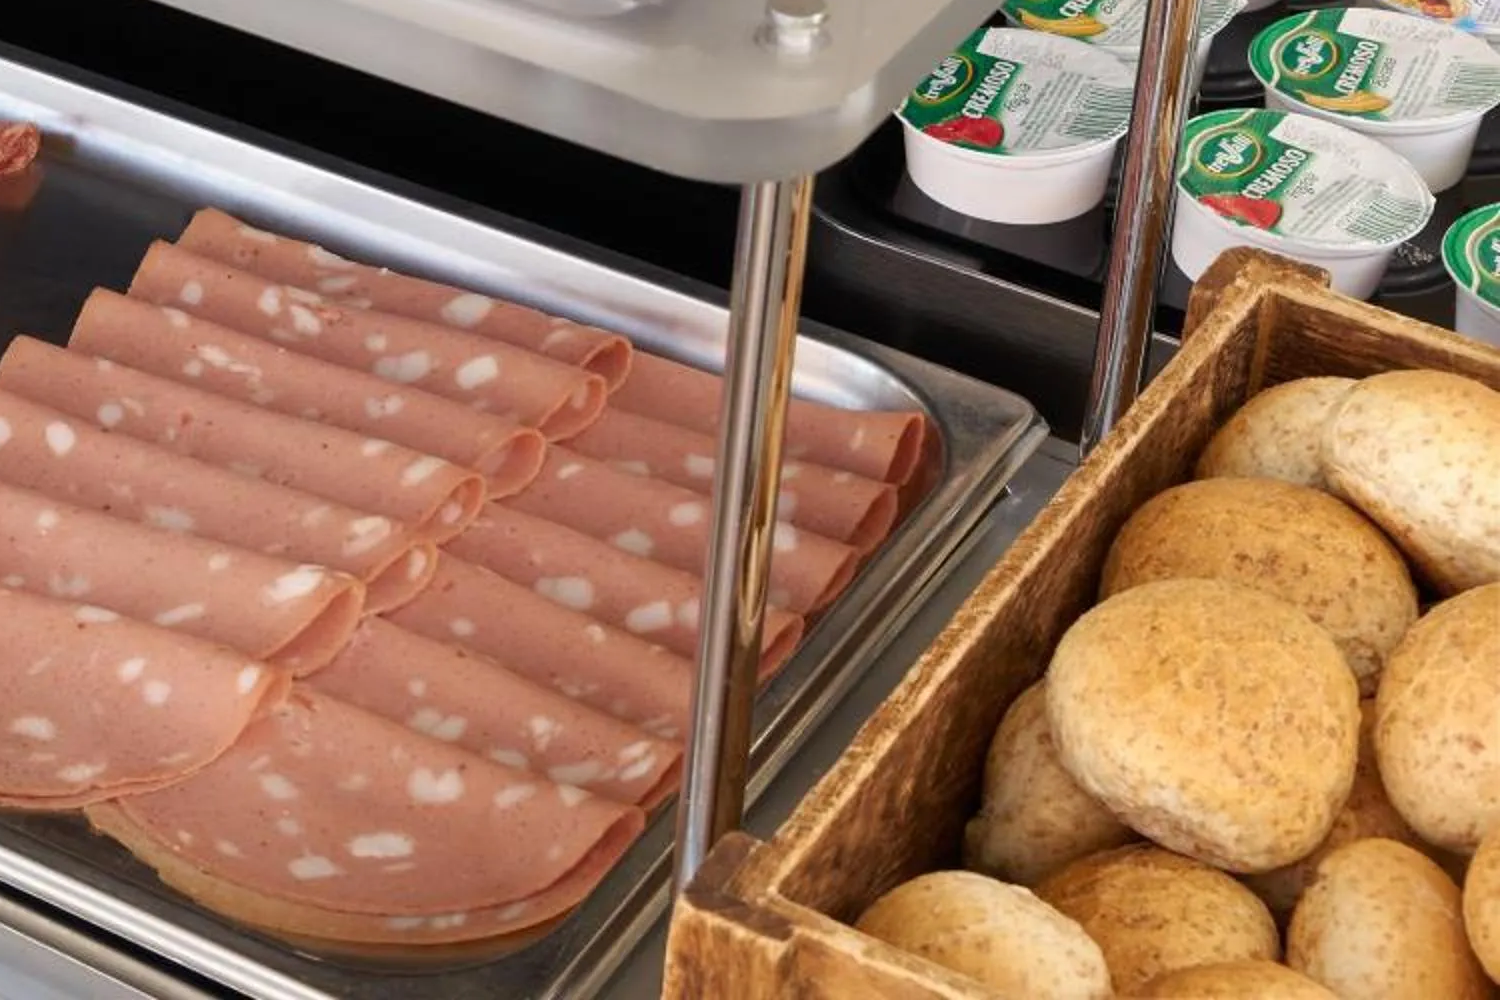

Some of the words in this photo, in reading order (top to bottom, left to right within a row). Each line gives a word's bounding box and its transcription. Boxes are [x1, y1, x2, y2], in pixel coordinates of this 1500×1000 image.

[962, 60, 1016, 118] CREMOSO
[1334, 41, 1380, 94] CREMOSO
[1242, 149, 1307, 199] CREMOSO
